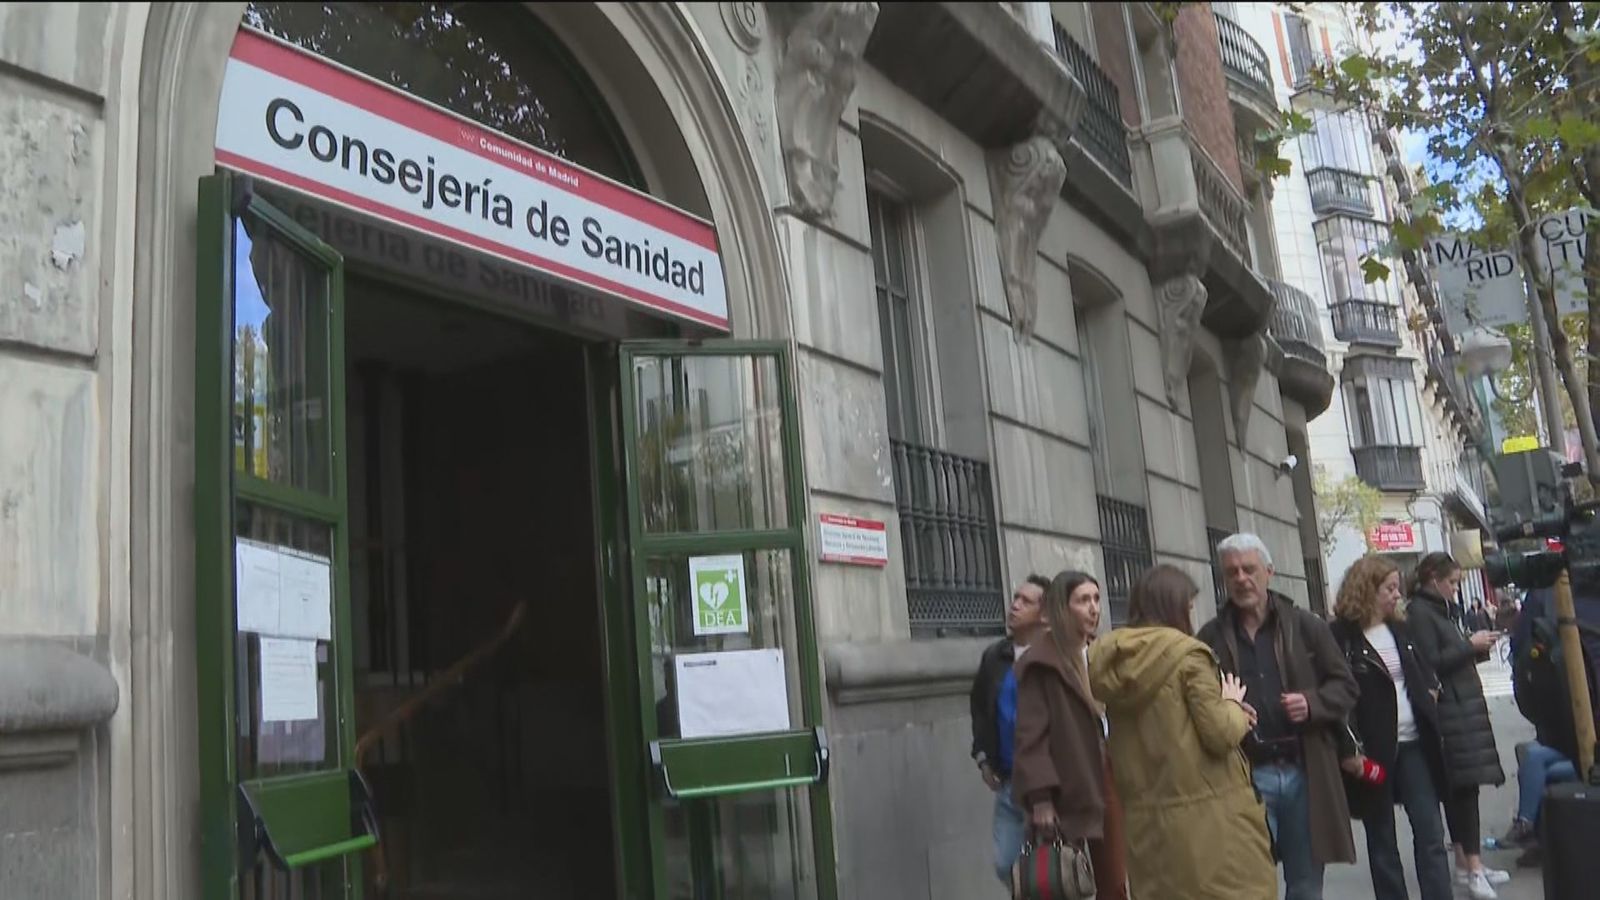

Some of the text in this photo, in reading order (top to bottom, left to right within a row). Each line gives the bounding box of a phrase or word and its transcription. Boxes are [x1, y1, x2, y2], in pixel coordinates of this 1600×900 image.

[479, 138, 579, 187] Comunidad de Madrid
[264, 96, 706, 297] Consejería de Sanidad
[1466, 253, 1514, 282] RID
[704, 610, 737, 627] DEA
